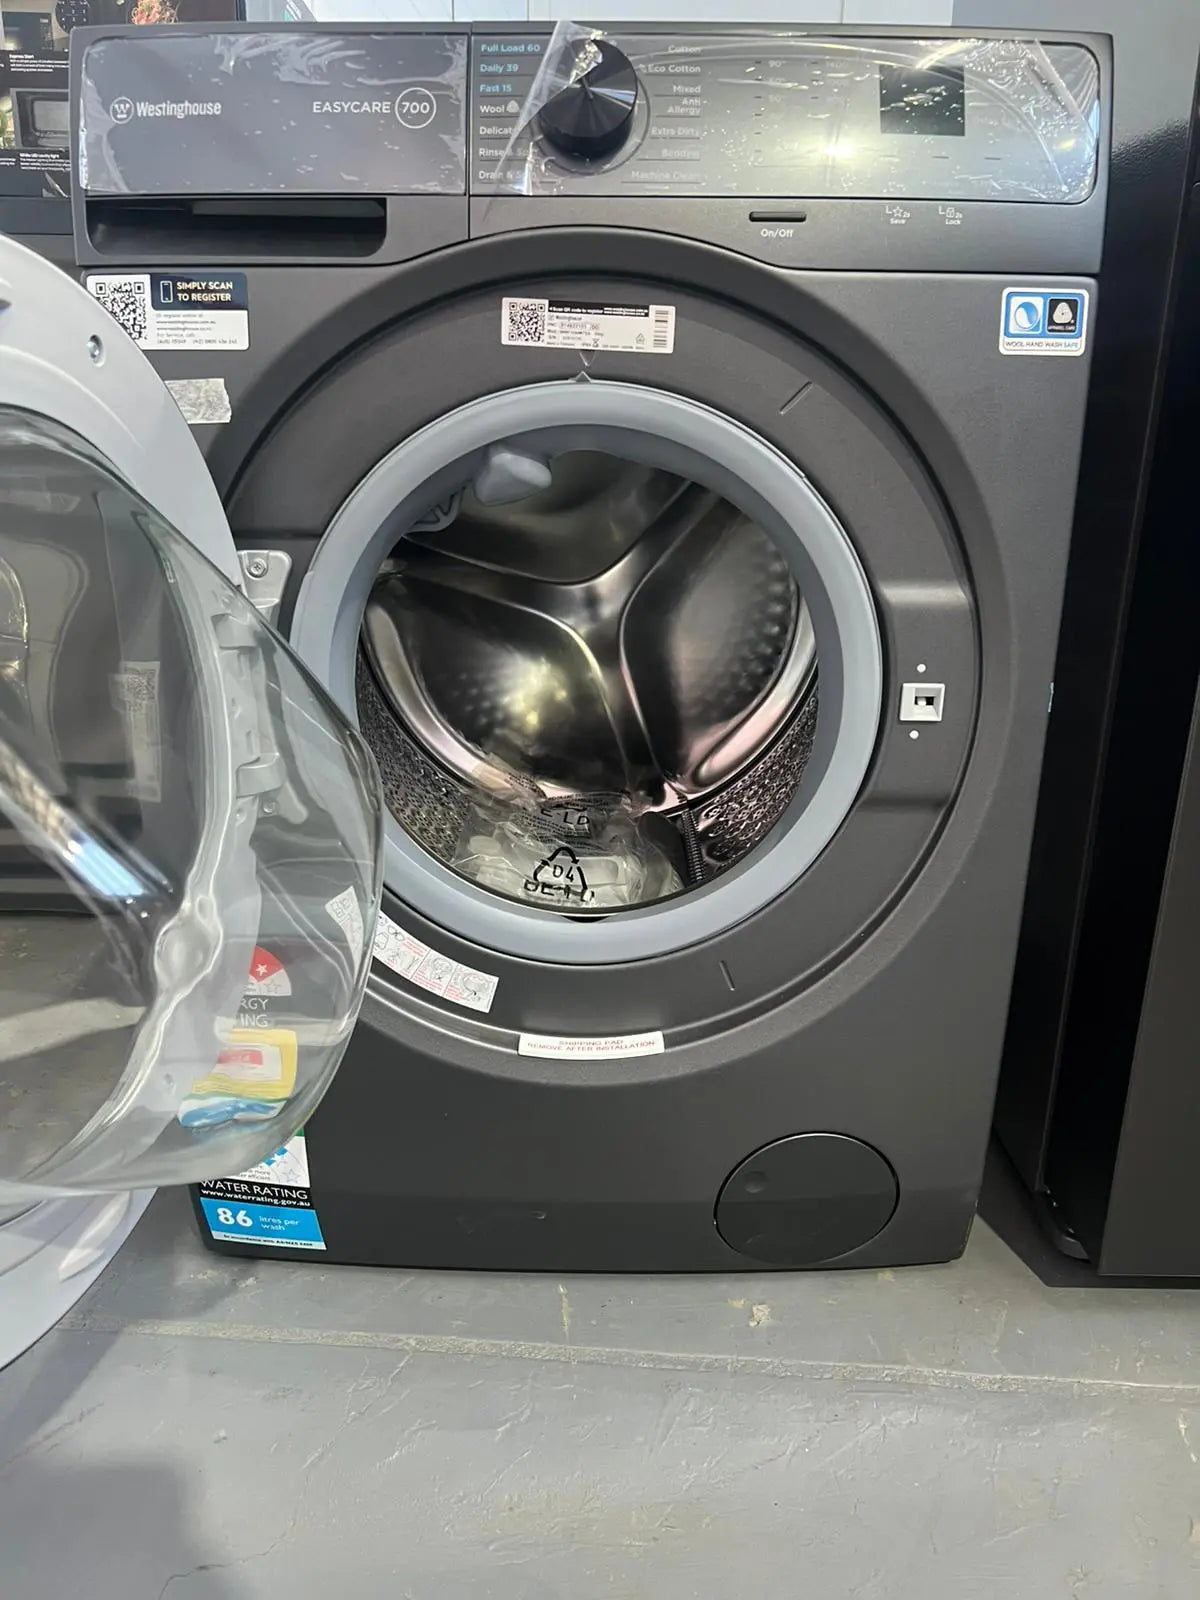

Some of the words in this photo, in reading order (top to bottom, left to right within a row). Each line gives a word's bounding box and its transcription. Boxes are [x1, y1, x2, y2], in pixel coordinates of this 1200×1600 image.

[481, 44, 498, 52] Full
[501, 44, 525, 52] Load
[527, 44, 540, 52] 60
[480, 63, 503, 74] Daily
[506, 63, 519, 72] 39
[648, 65, 665, 73] Eco
[668, 65, 701, 73] Cotton
[480, 84, 499, 93] Fast
[502, 84, 512, 93] 15
[673, 85, 701, 93] Mixed
[136, 100, 222, 119] Westinghouse
[312, 101, 391, 113] EASYCARE
[401, 101, 430, 114] 700
[480, 105, 504, 113] Wool
[667, 106, 701, 116] Allergy
[651, 127, 676, 135] Extra
[760, 228, 794, 239] On/Off
[177, 281, 206, 291] SIMPLY
[208, 281, 233, 290] SCAN
[177, 292, 190, 301] TO
[191, 292, 231, 301] REGISTER
[528, 1042, 563, 1051] REMOVE
[596, 1040, 655, 1051] INSTALLATION
[200, 1180, 250, 1194] WATER
[252, 1186, 308, 1200] RATING
[201, 1188, 311, 1207] www.waterrating.gov.au
[216, 1207, 253, 1227] 86
[259, 1215, 281, 1225] litres
[284, 1218, 300, 1227] per
[261, 1223, 286, 1231] wash
